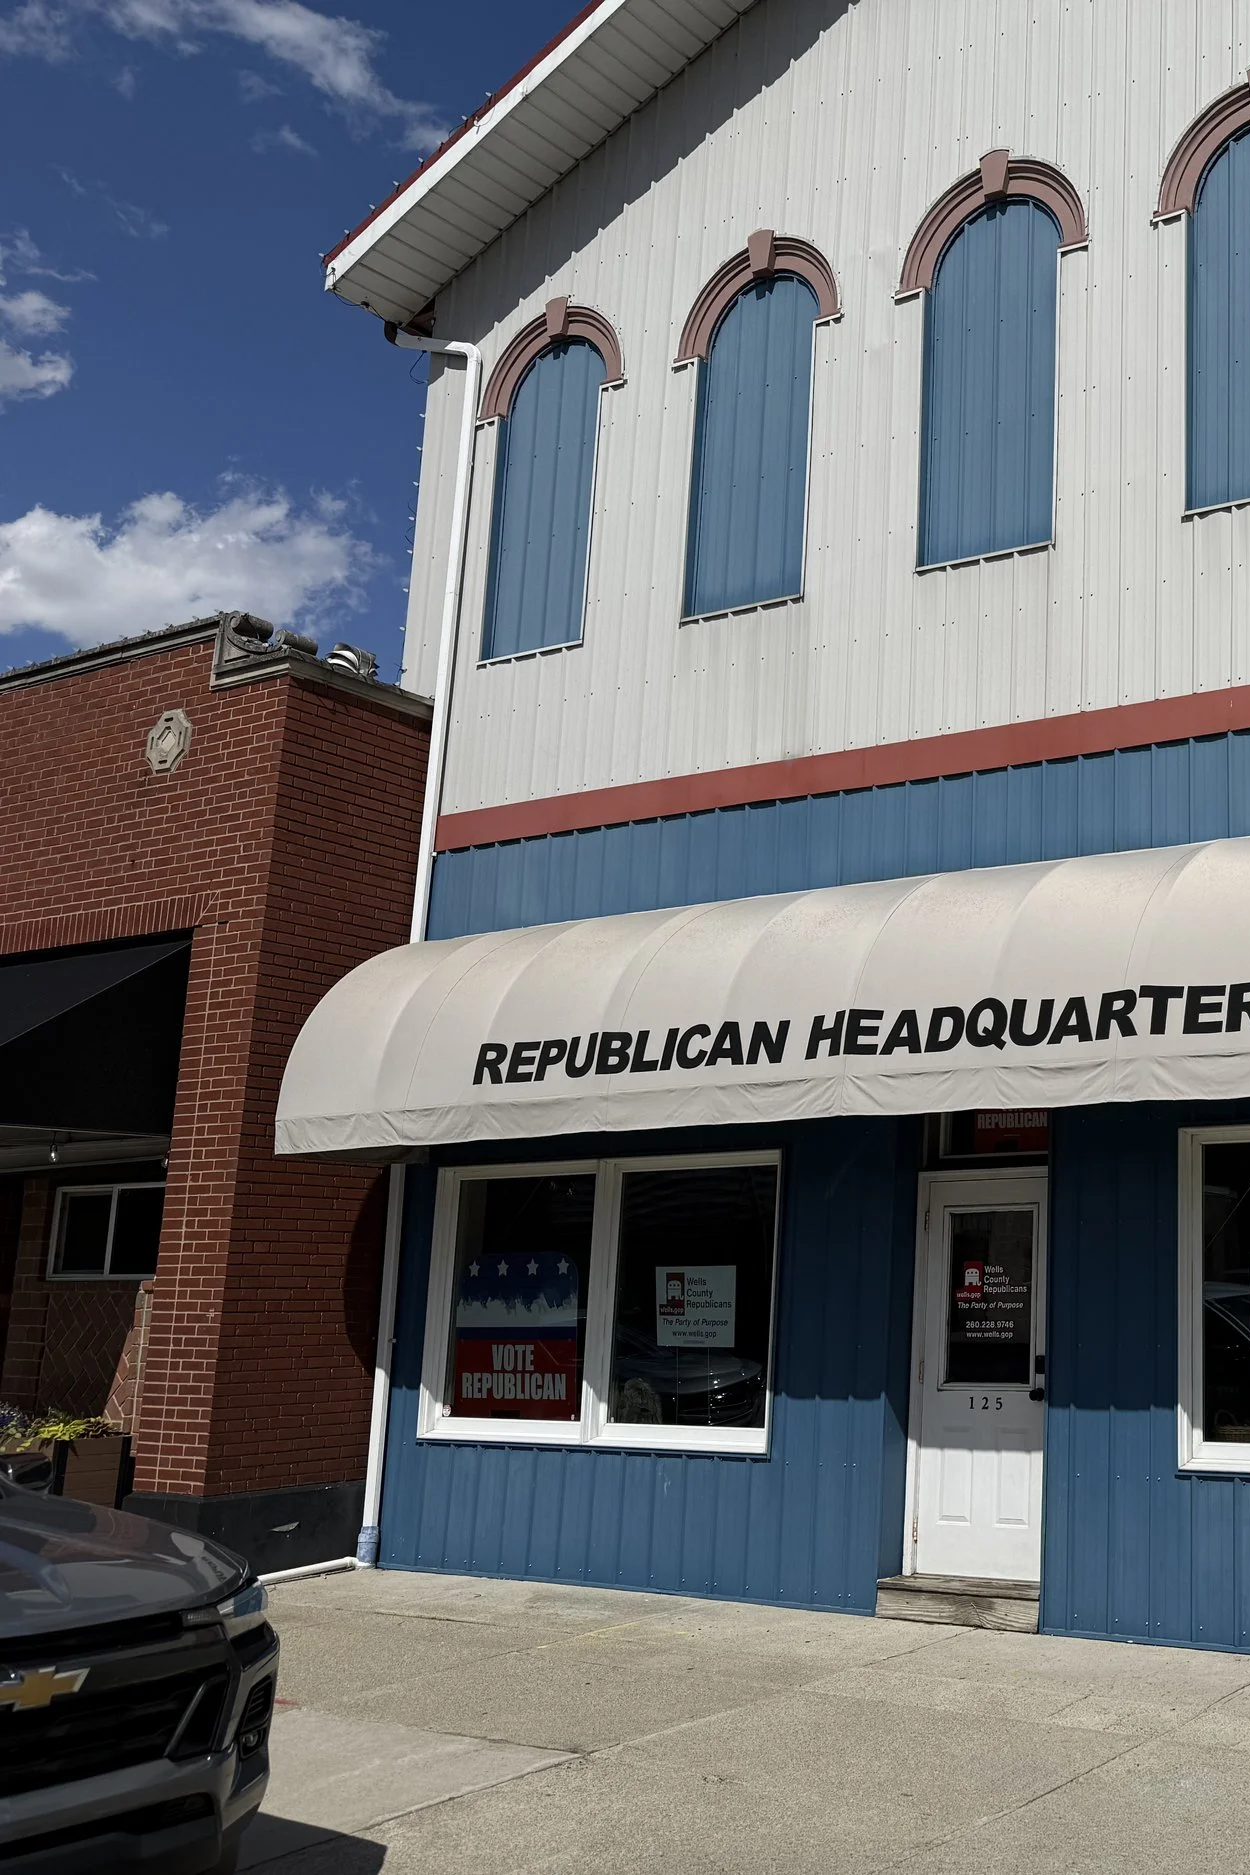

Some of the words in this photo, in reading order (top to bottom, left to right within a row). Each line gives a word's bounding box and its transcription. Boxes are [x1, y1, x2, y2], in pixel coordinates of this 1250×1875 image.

[472, 1019, 790, 1086] REPUBLICAN
[977, 1111, 1048, 1129] REPUBLICAN
[984, 1266, 1004, 1274] Wells
[687, 1278, 707, 1286] Wells
[984, 1276, 1010, 1285] County
[686, 1289, 713, 1299] County
[984, 1285, 1027, 1294] Republicans
[686, 1300, 732, 1309] Republicans
[971, 1302, 988, 1310] Party
[998, 1302, 1024, 1310] Purpose
[663, 1318, 674, 1326] The
[675, 1319, 691, 1327] Party
[702, 1319, 729, 1327] Purpose
[672, 1331, 717, 1339] www.wells.gop
[966, 1331, 1013, 1339] www.wells.gop
[492, 1344, 535, 1372] VOTE
[461, 1372, 566, 1400] REPUBLICAN
[969, 1396, 1003, 1410] 125
